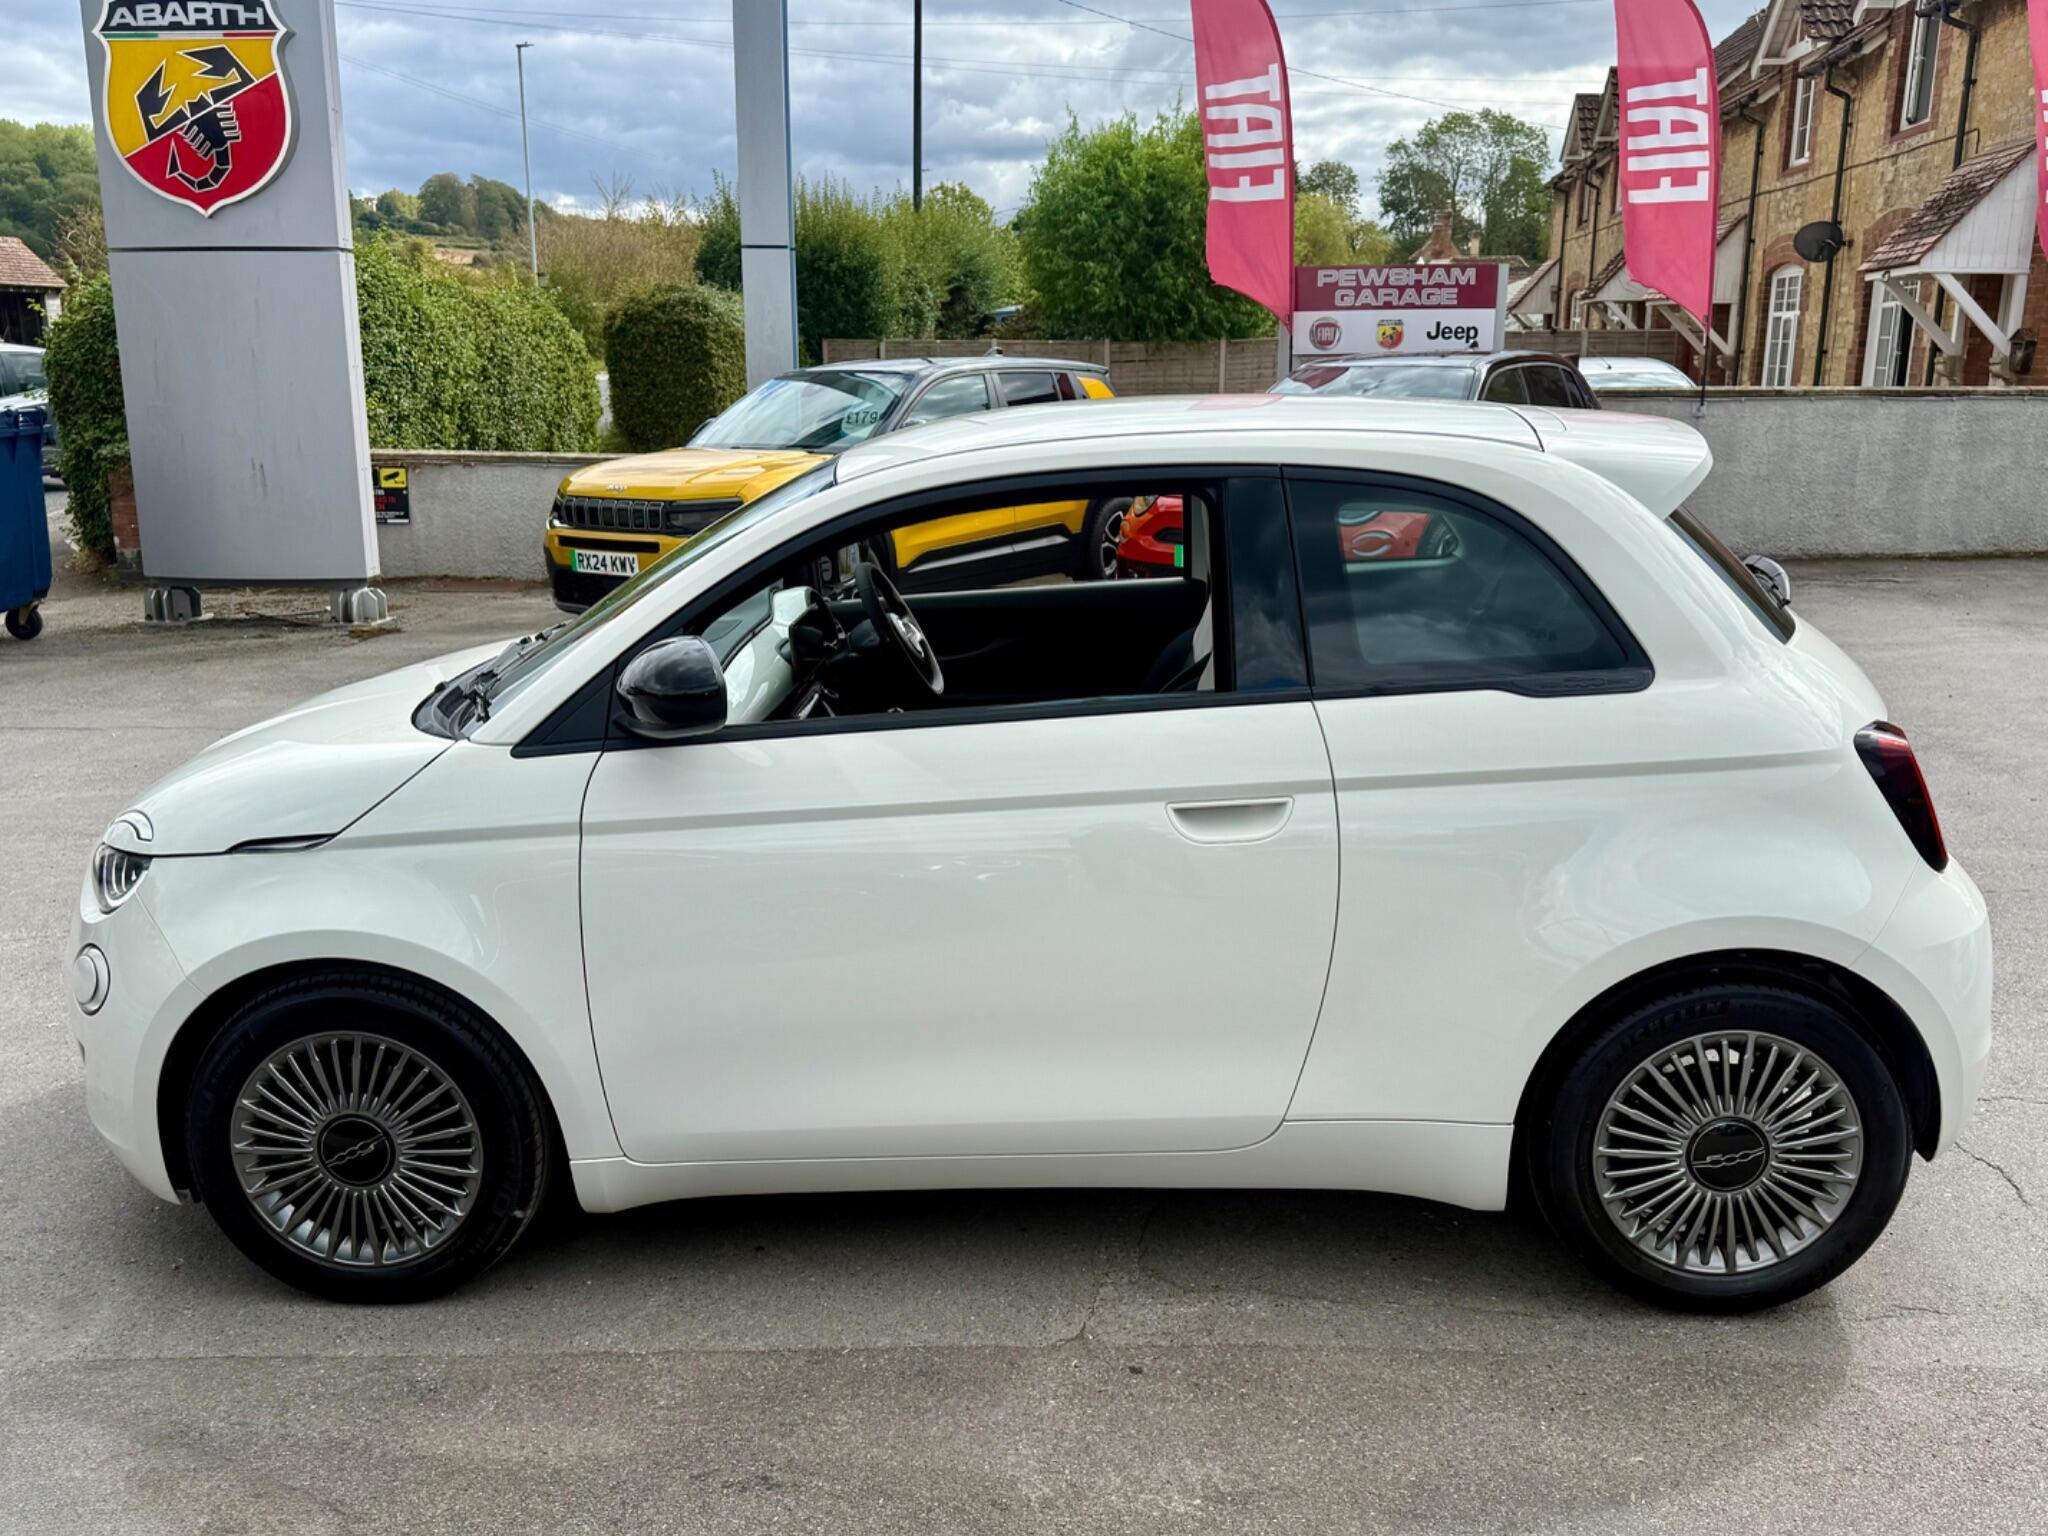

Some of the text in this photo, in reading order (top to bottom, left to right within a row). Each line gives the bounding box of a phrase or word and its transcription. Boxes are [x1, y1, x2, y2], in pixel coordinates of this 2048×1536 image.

[108, 1, 265, 27] ABARTH
[1317, 267, 1477, 287] PEWSHAM
[1334, 287, 1458, 307] GARAGE
[1426, 321, 1478, 343] Jeep
[577, 553, 607, 571] RX24
